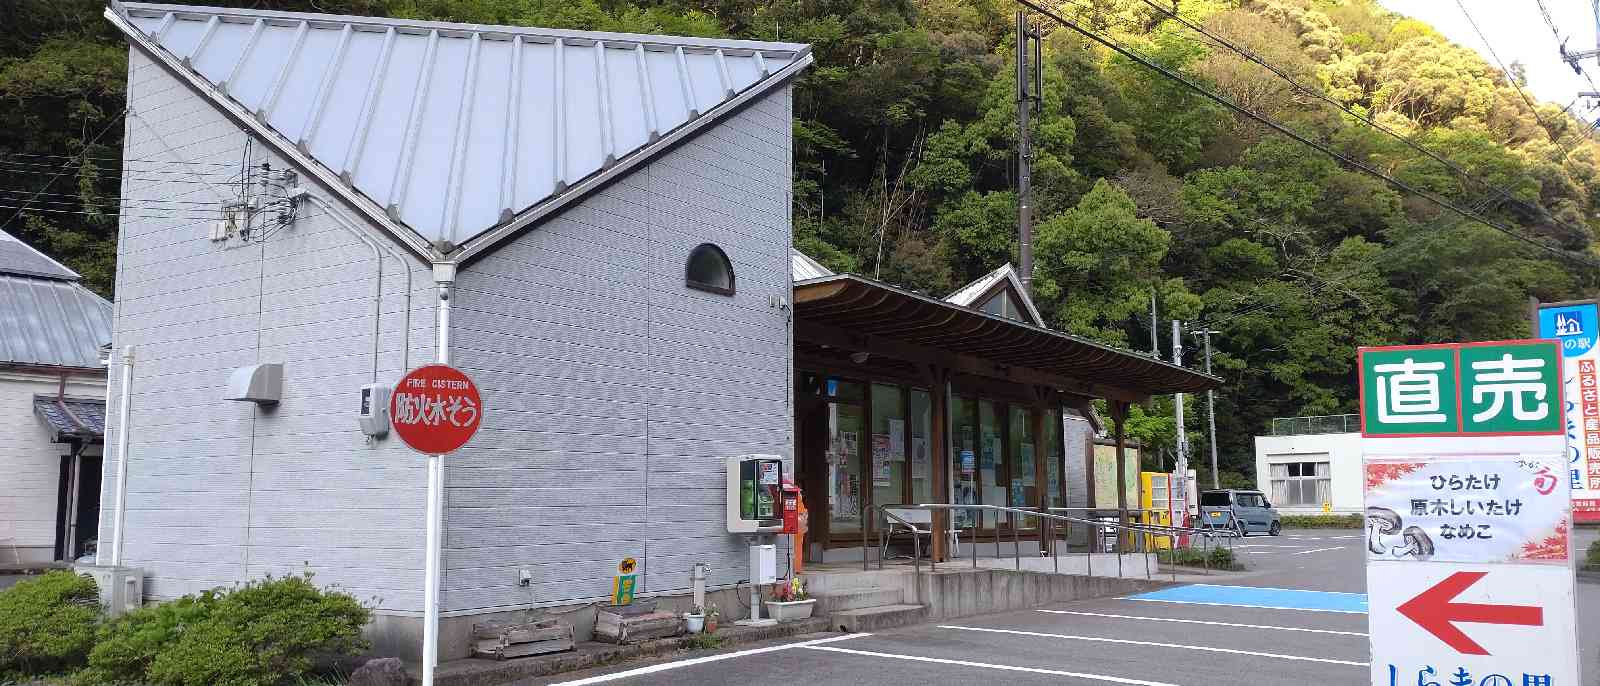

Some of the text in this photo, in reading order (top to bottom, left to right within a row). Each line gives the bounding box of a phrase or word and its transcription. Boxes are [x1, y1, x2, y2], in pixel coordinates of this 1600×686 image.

[406, 378, 469, 390] FIRE CISTERN
[1373, 353, 1549, 424] 直売
[394, 391, 477, 427] 防火水そう
[1430, 473, 1501, 491] ひらたけ
[1410, 499, 1523, 517] 原木しいたけ
[1440, 523, 1493, 540] なめこ
